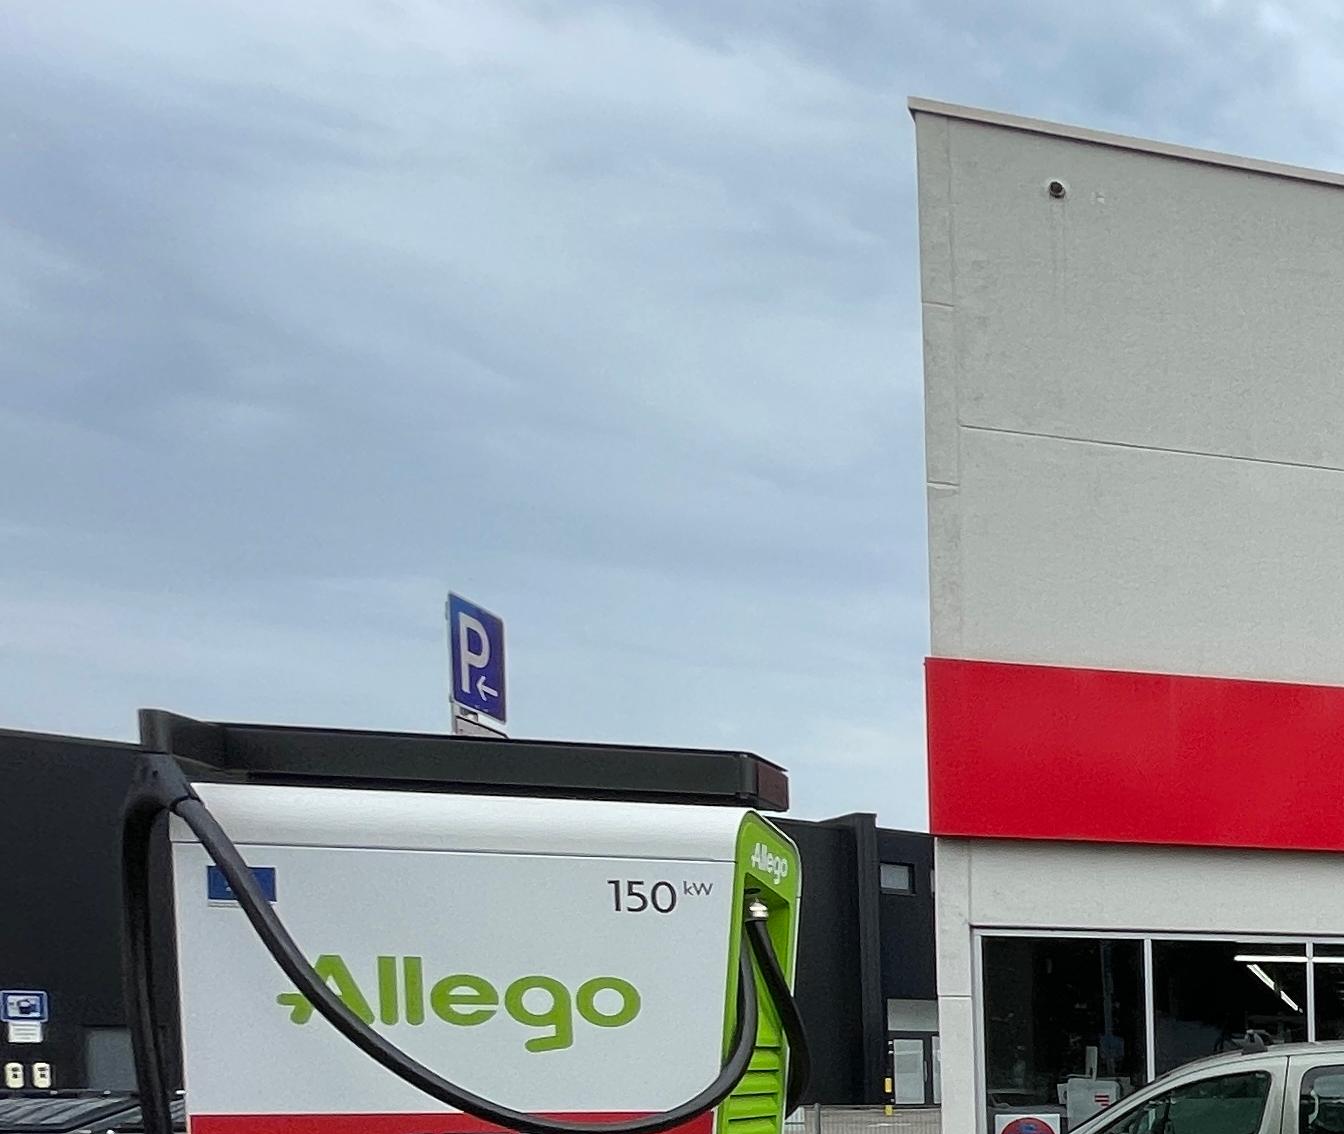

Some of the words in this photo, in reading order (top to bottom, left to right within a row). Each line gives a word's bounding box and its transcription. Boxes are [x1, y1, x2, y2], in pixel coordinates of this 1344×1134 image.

[459, 611, 491, 694] P
[751, 842, 788, 885] Allego
[606, 879, 677, 913] 150
[683, 881, 713, 896] kW
[276, 953, 641, 1053] Allego
